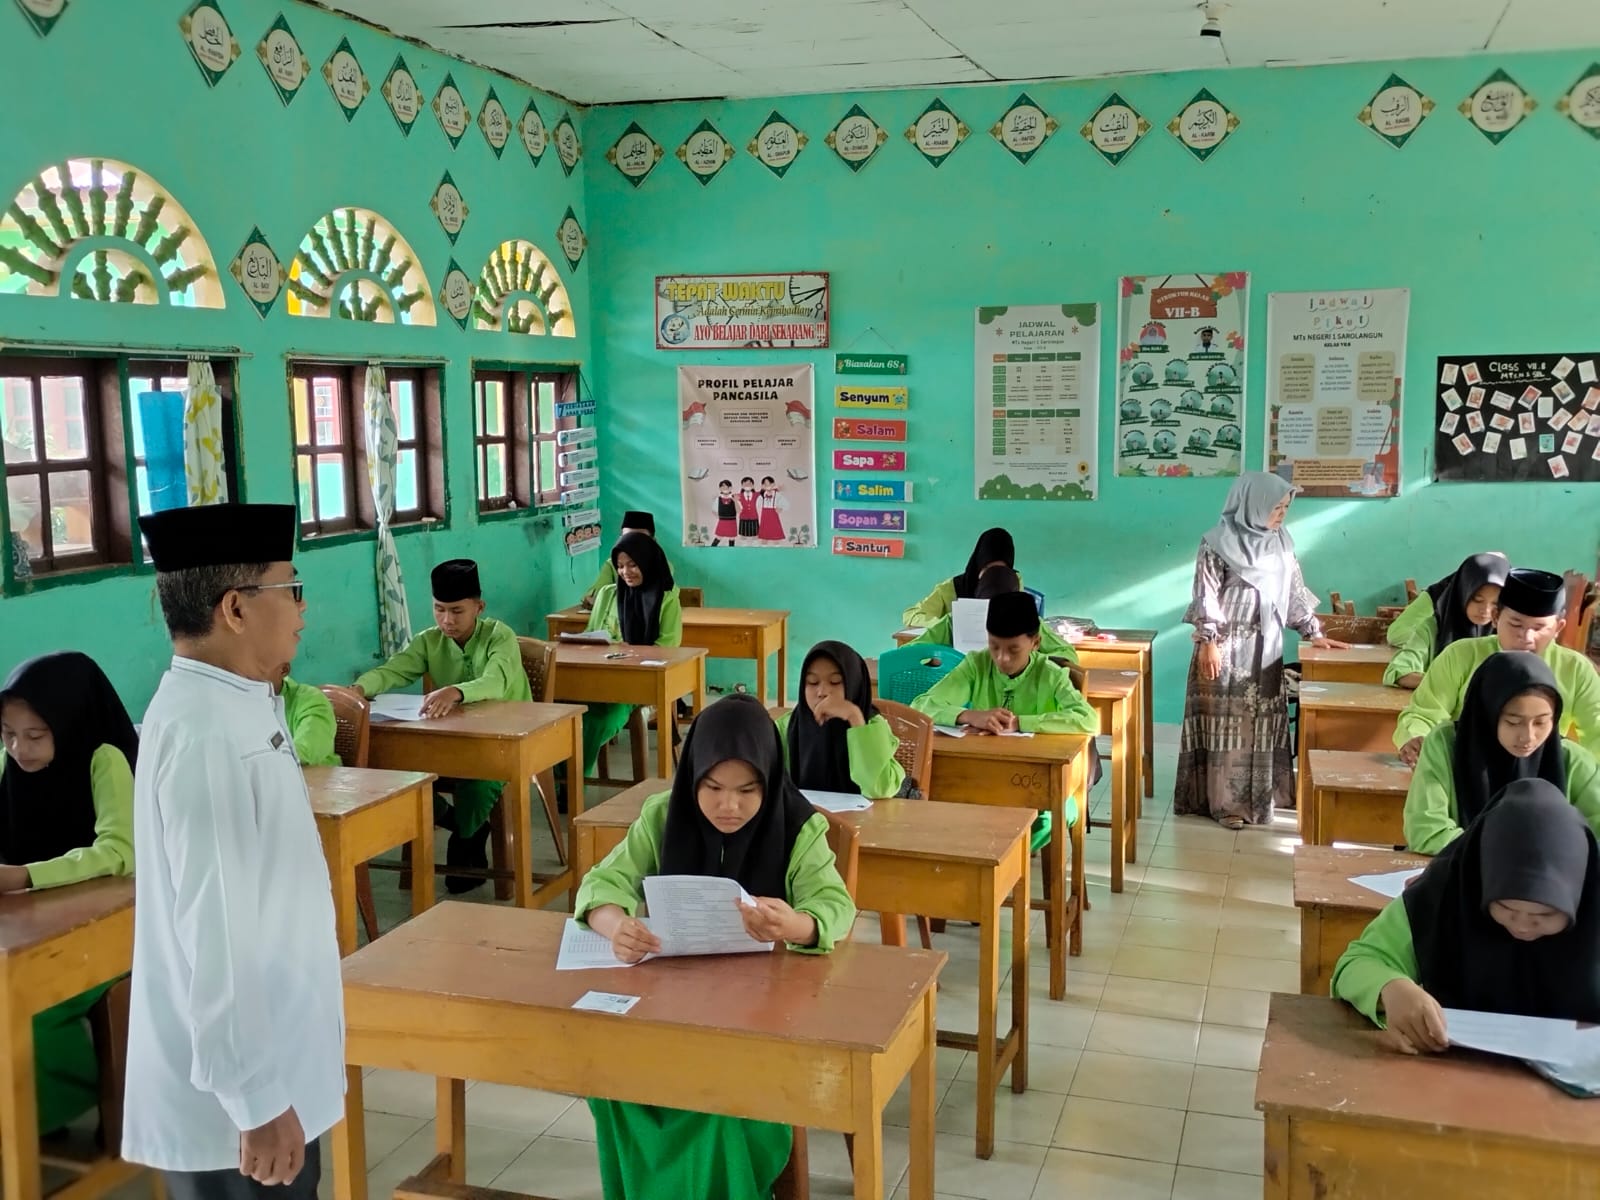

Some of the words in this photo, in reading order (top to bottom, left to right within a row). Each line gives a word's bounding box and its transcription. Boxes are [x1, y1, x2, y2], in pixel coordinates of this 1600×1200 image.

[666, 282, 719, 302] TEPAT
[721, 281, 786, 301] WAKTU
[696, 306, 727, 317] Adalah
[1164, 306, 1201, 318] VII-B
[1019, 320, 1056, 329] JADWAL
[694, 325, 712, 341] AYO
[712, 324, 747, 341] BELAJAR
[750, 323, 770, 340] DARI
[772, 323, 815, 340] SEKARANG
[1009, 330, 1065, 338] PELAJARAN
[1307, 333, 1332, 341] NEGERI
[1337, 332, 1383, 340] SAROLANGUN
[844, 359, 885, 369] Biasakan
[887, 359, 900, 369] 6S
[1488, 361, 1520, 373] Class
[698, 379, 739, 389] PROFIL
[743, 378, 794, 389] PELAJAR
[713, 391, 778, 401] PANCASILA
[840, 391, 890, 405] Senyum
[857, 424, 896, 437] Salam
[842, 454, 875, 468] Sapa
[858, 483, 894, 496] Salim
[838, 513, 878, 529] Sopan
[846, 541, 891, 554] Santun
[1010, 771, 1042, 790] 006
